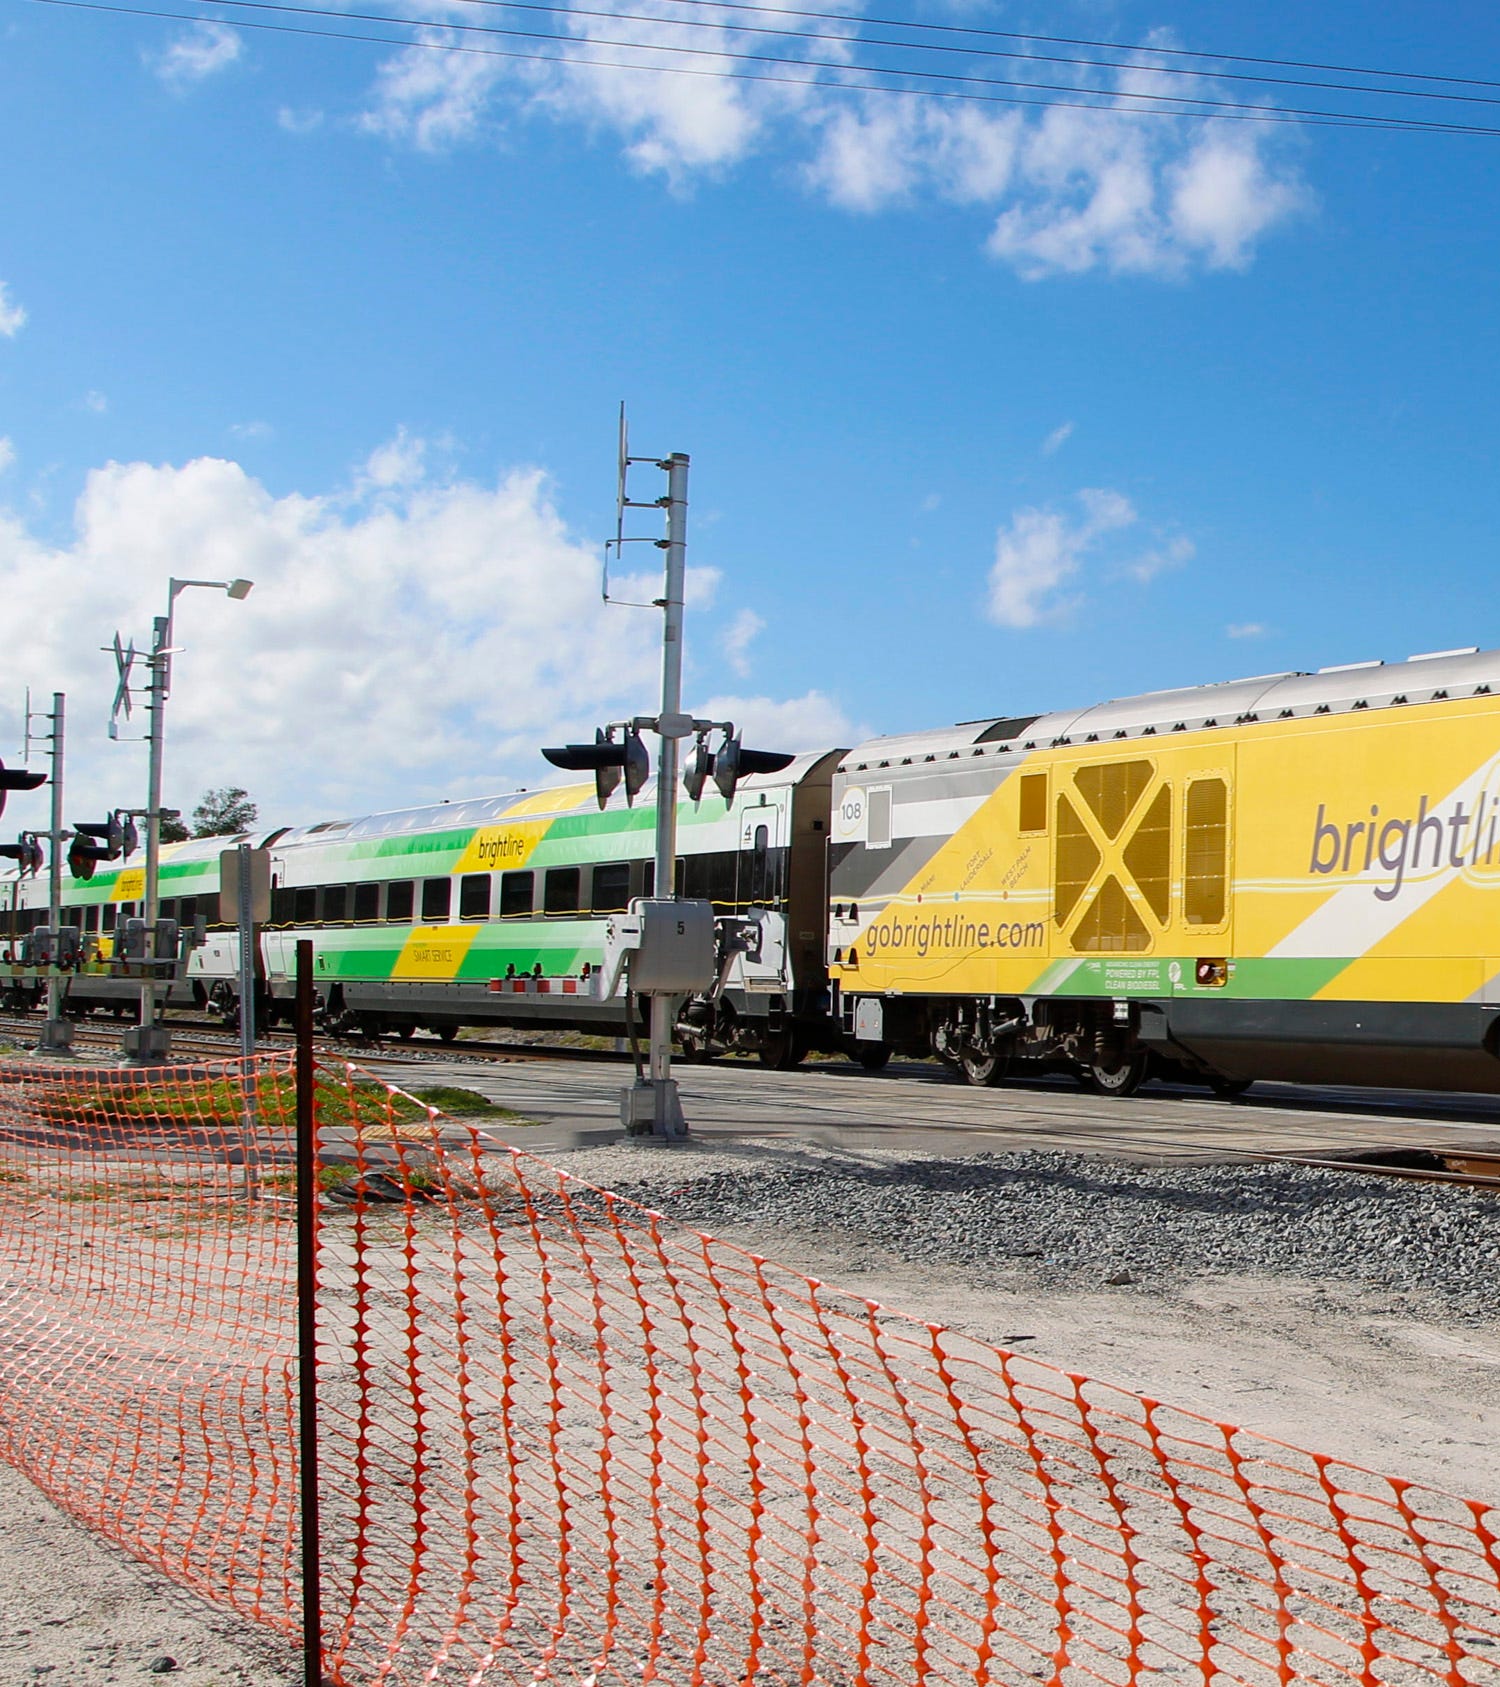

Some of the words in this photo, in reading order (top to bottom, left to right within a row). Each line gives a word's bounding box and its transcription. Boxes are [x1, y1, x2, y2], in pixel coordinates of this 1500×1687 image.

[842, 803, 861, 820] 108
[744, 824, 751, 841] 4
[478, 832, 524, 868] brightline
[677, 921, 685, 935] 5
[866, 915, 1044, 957] gobrightline.com
